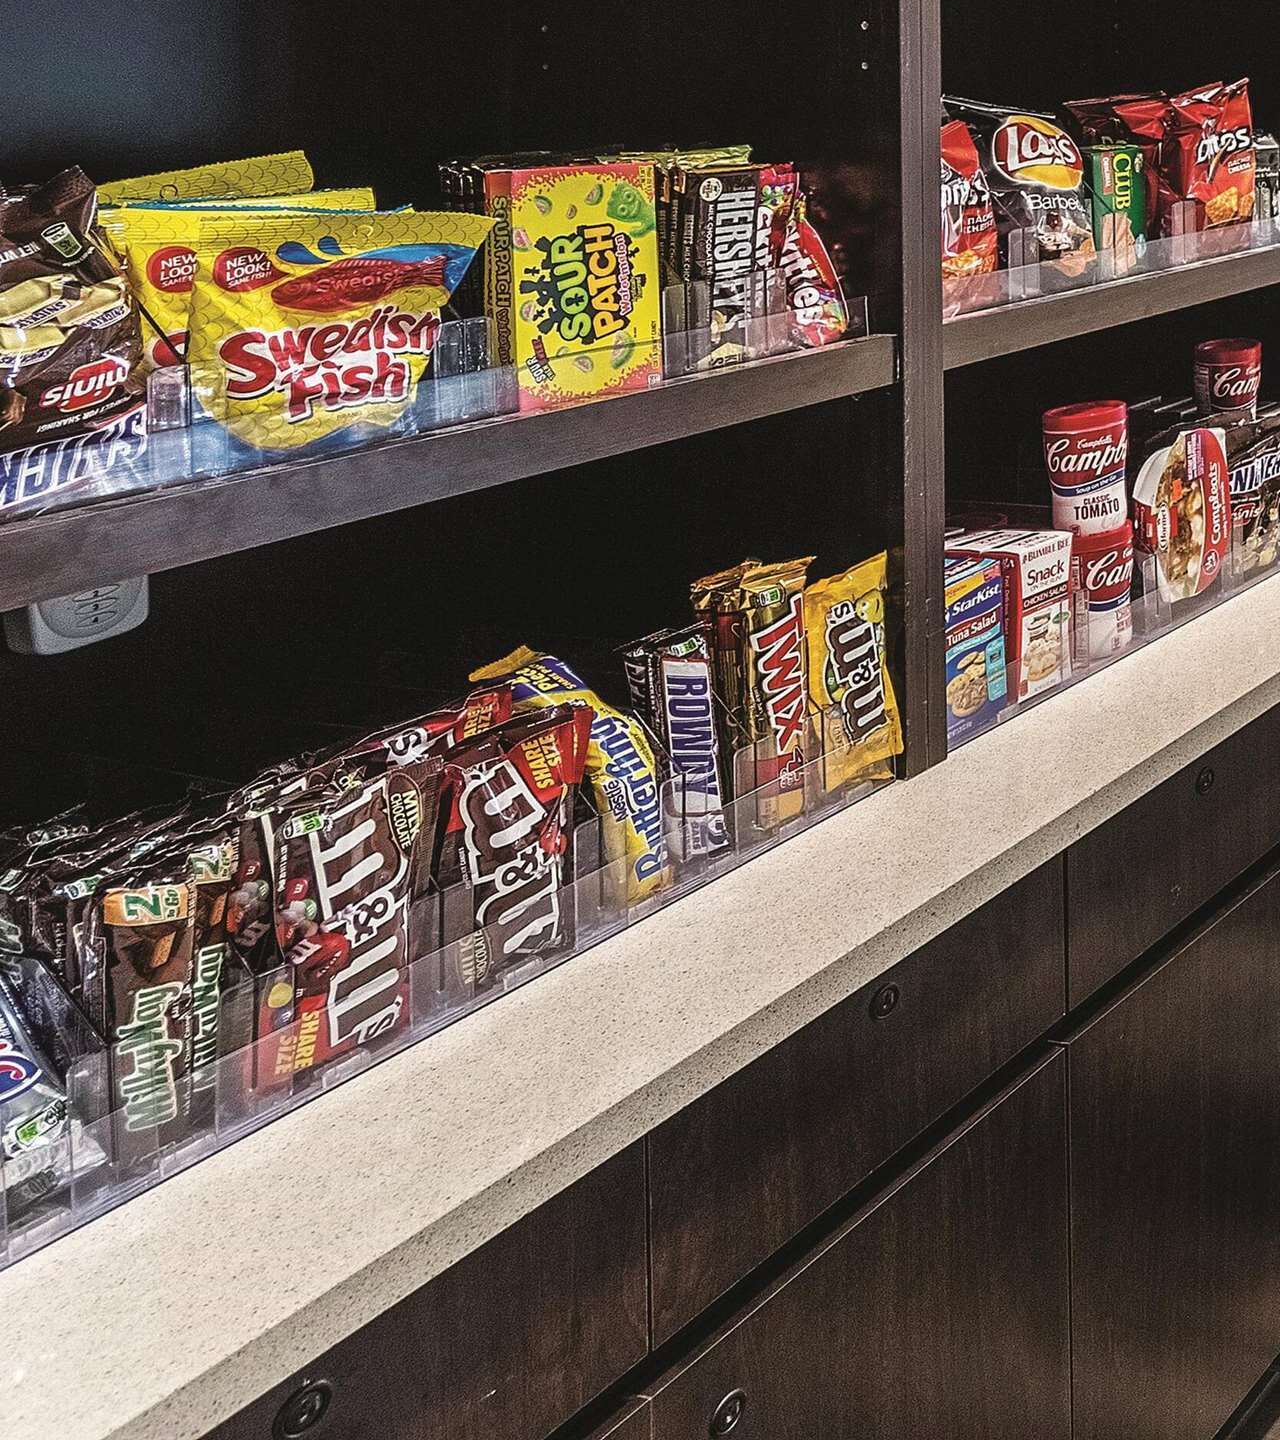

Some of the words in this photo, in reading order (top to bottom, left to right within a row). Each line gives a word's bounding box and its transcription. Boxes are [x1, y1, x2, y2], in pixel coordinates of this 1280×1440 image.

[1006, 126, 1077, 172] Lay's
[1029, 192, 1087, 212] Barbec
[1111, 152, 1132, 210] CLUB
[225, 253, 265, 270] NEW
[225, 262, 272, 282] LOOK!
[583, 223, 625, 338] PATCH
[712, 191, 757, 332] HERSHEY'S
[551, 233, 592, 341] SOUR
[219, 304, 442, 398] Swedish
[41, 362, 129, 408] minis
[286, 352, 410, 423] Fish
[1073, 498, 1121, 521] TOMATO
[1083, 493, 1112, 506] CLASSIC
[1026, 560, 1065, 586] Snack
[1049, 584, 1068, 597] SALAD
[951, 583, 1001, 617] StarKist
[946, 629, 970, 647] Tuna
[970, 612, 997, 635] Salad
[750, 592, 806, 754] TWIX
[539, 731, 563, 768] SIZE
[664, 674, 719, 798] ROWDY
[521, 737, 555, 790] SHARE
[390, 793, 412, 849] CHOCOLATE
[402, 790, 420, 844] MILK
[125, 894, 162, 921] 2
[300, 1008, 321, 1073] SHARE
